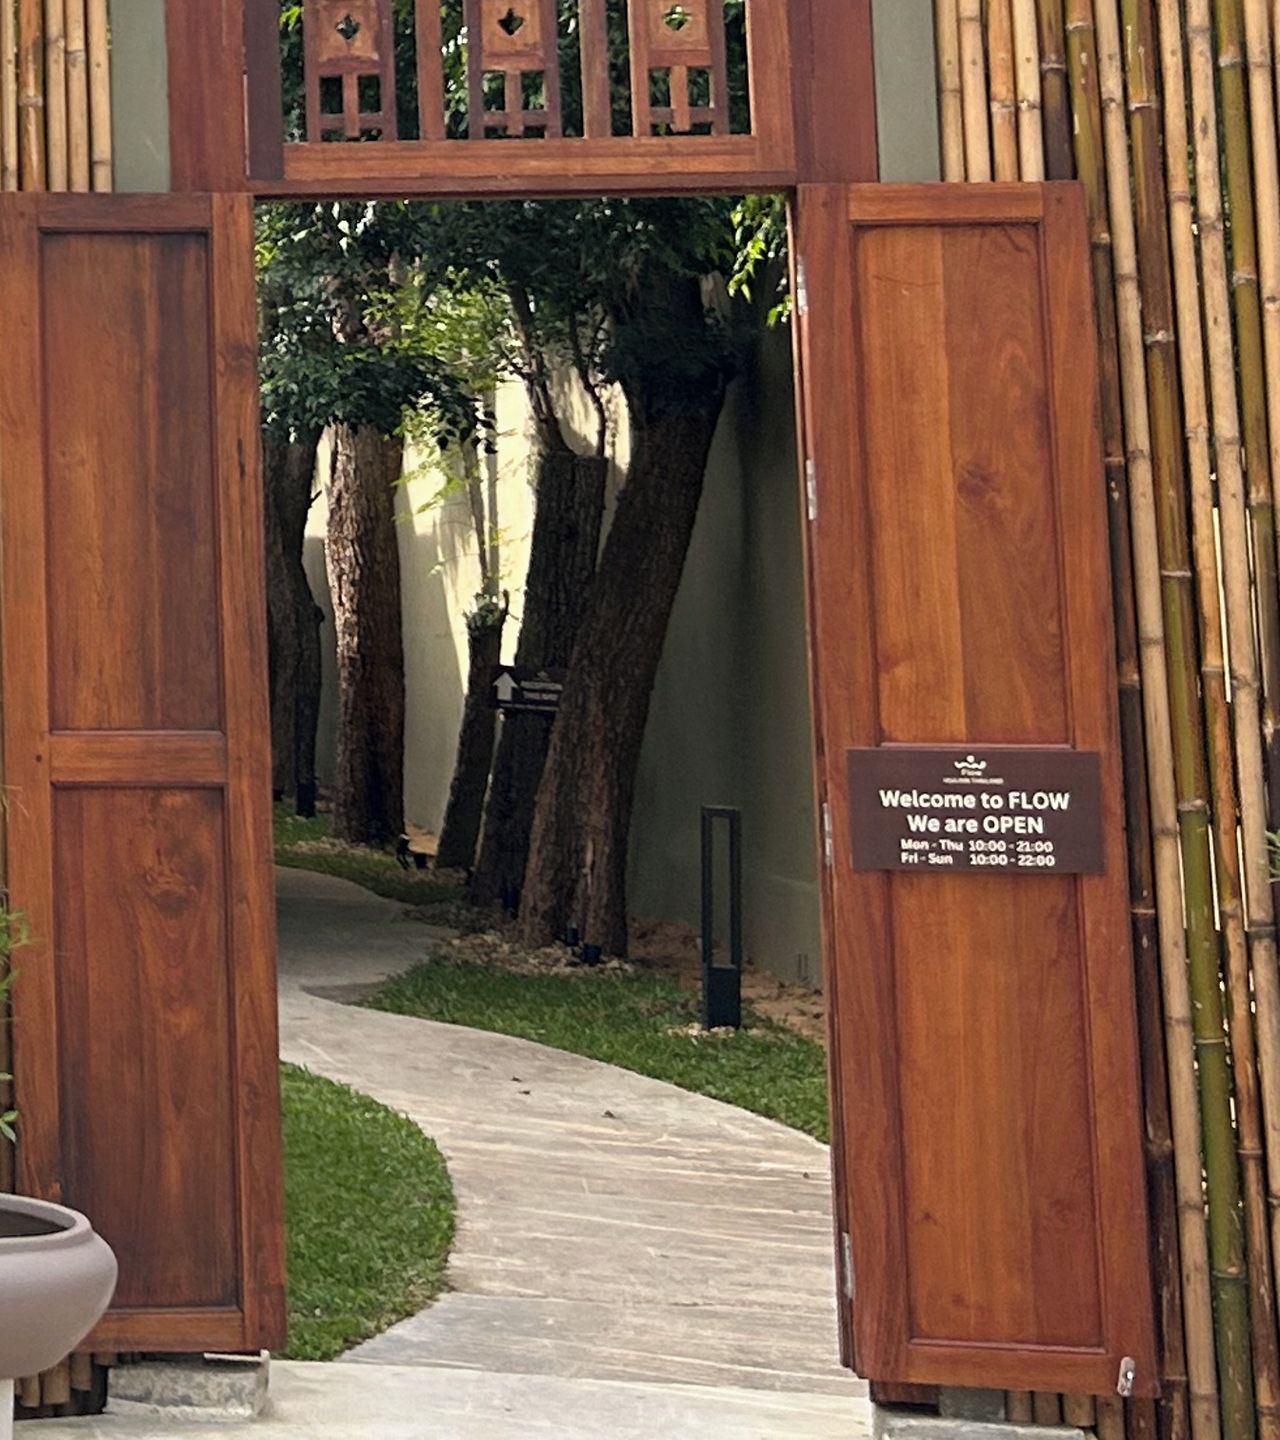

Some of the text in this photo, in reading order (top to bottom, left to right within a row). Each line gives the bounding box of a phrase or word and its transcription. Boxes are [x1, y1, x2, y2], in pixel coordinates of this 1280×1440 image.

[879, 789, 1070, 811] Welcome to FLOW
[906, 814, 1044, 834] We are OPEN
[901, 838, 929, 851] Mon
[939, 839, 964, 852] Thu
[968, 840, 1006, 852] 10:00
[1016, 841, 1053, 853] 21:00
[901, 852, 918, 864] Fri
[928, 853, 953, 865] Sun
[970, 854, 1007, 866] 10:00
[1017, 855, 1055, 867] 22:00
